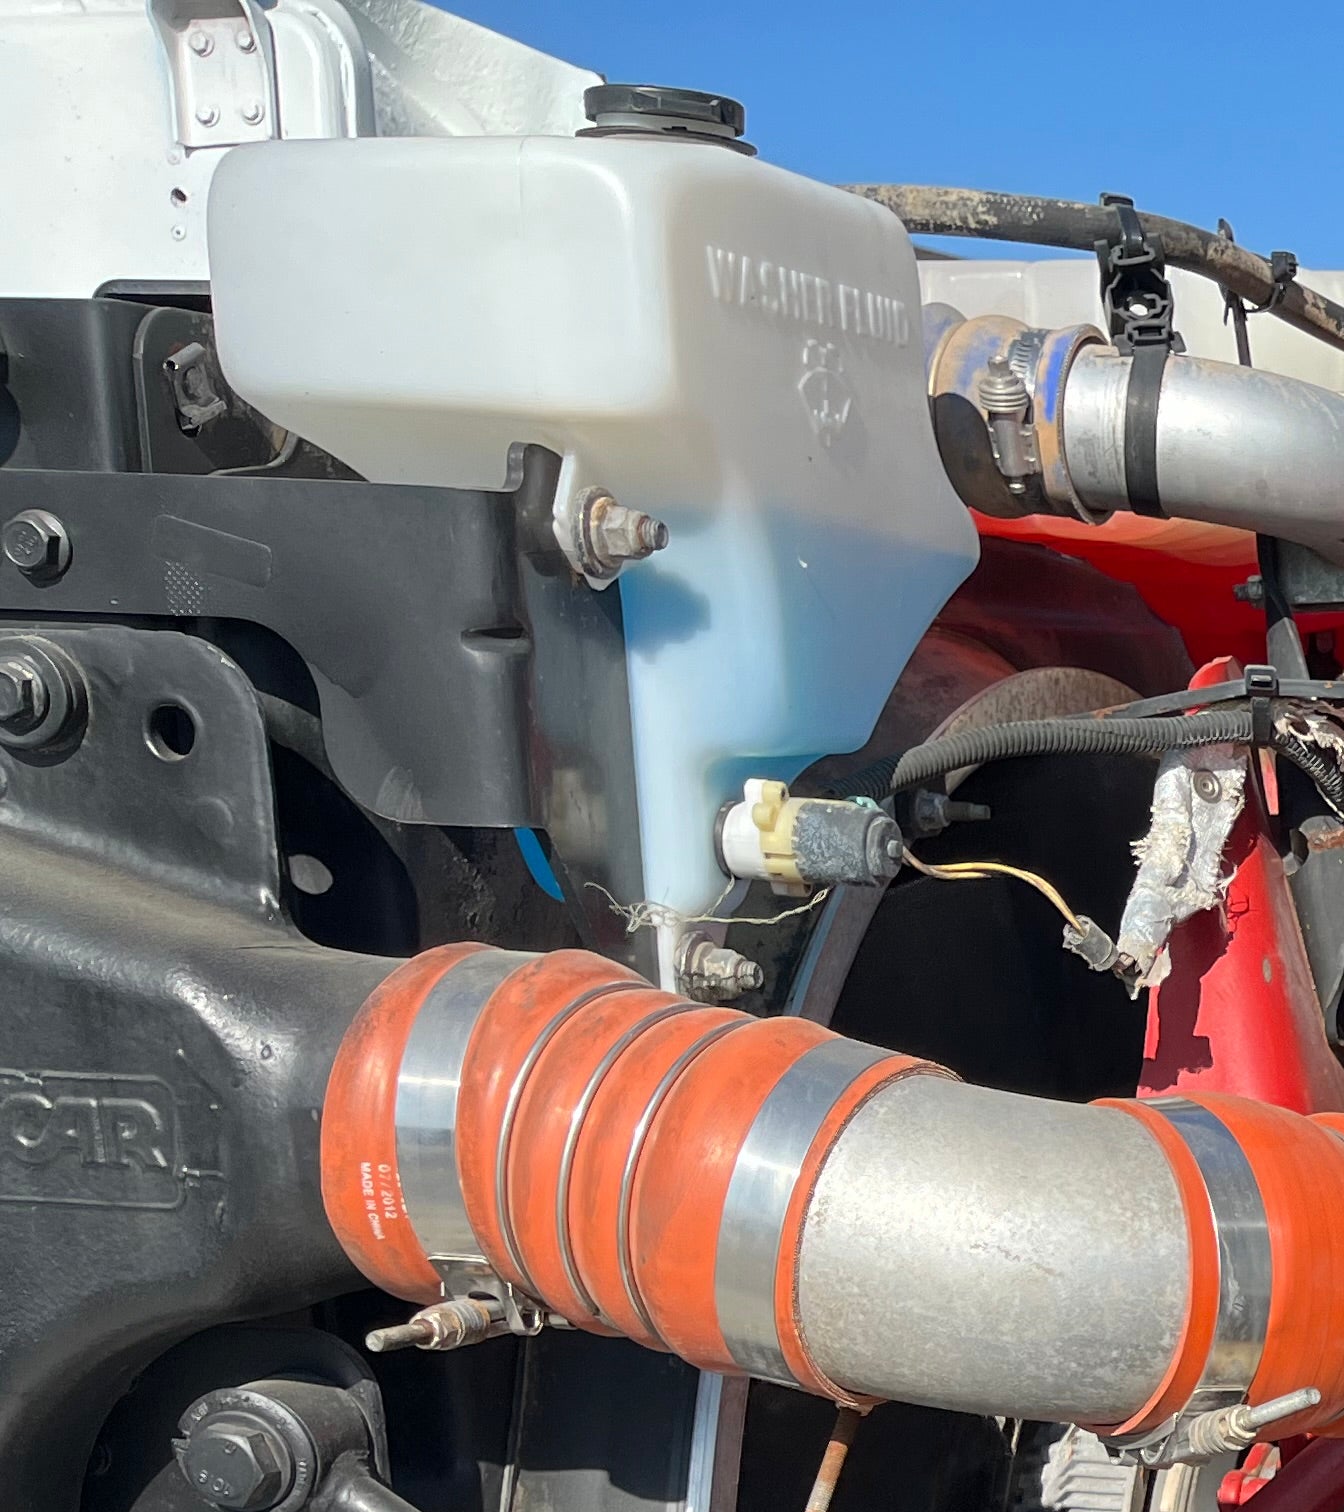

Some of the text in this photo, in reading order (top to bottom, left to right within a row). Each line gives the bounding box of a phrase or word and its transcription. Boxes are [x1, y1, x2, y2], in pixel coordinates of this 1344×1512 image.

[706, 244, 910, 350] WASHER FLUID
[360, 1161, 375, 1197] MADE
[365, 1200, 377, 1211] IN
